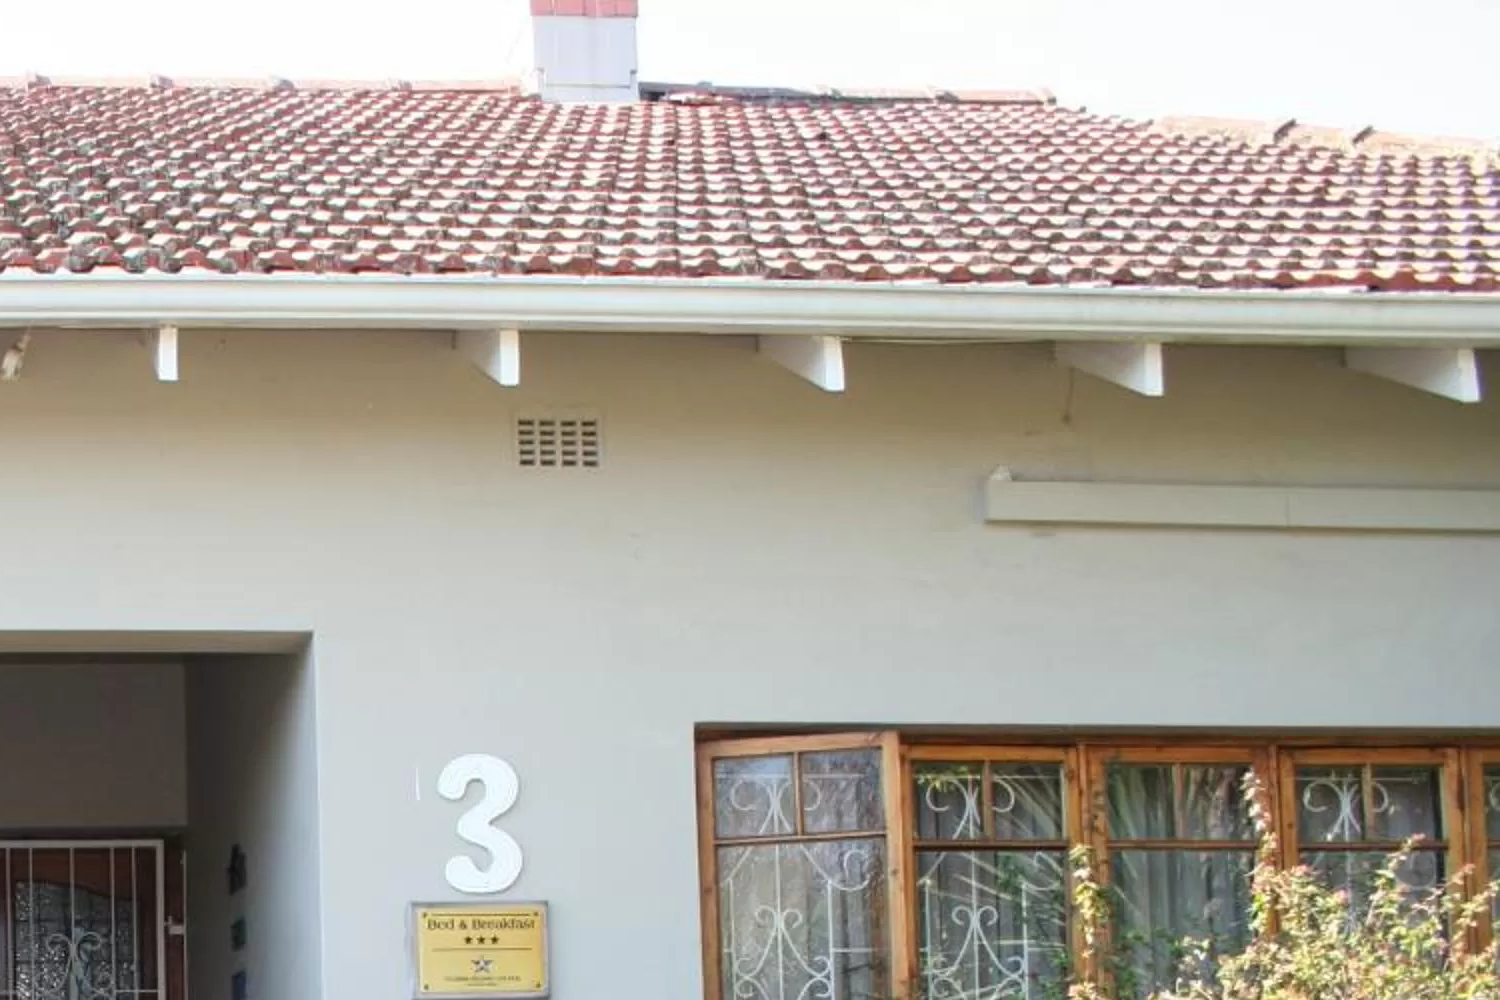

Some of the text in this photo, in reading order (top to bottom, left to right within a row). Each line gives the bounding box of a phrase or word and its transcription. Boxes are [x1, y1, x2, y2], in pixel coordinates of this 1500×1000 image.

[436, 752, 523, 893] 3
[427, 917, 535, 930] Bed & Breakfast
